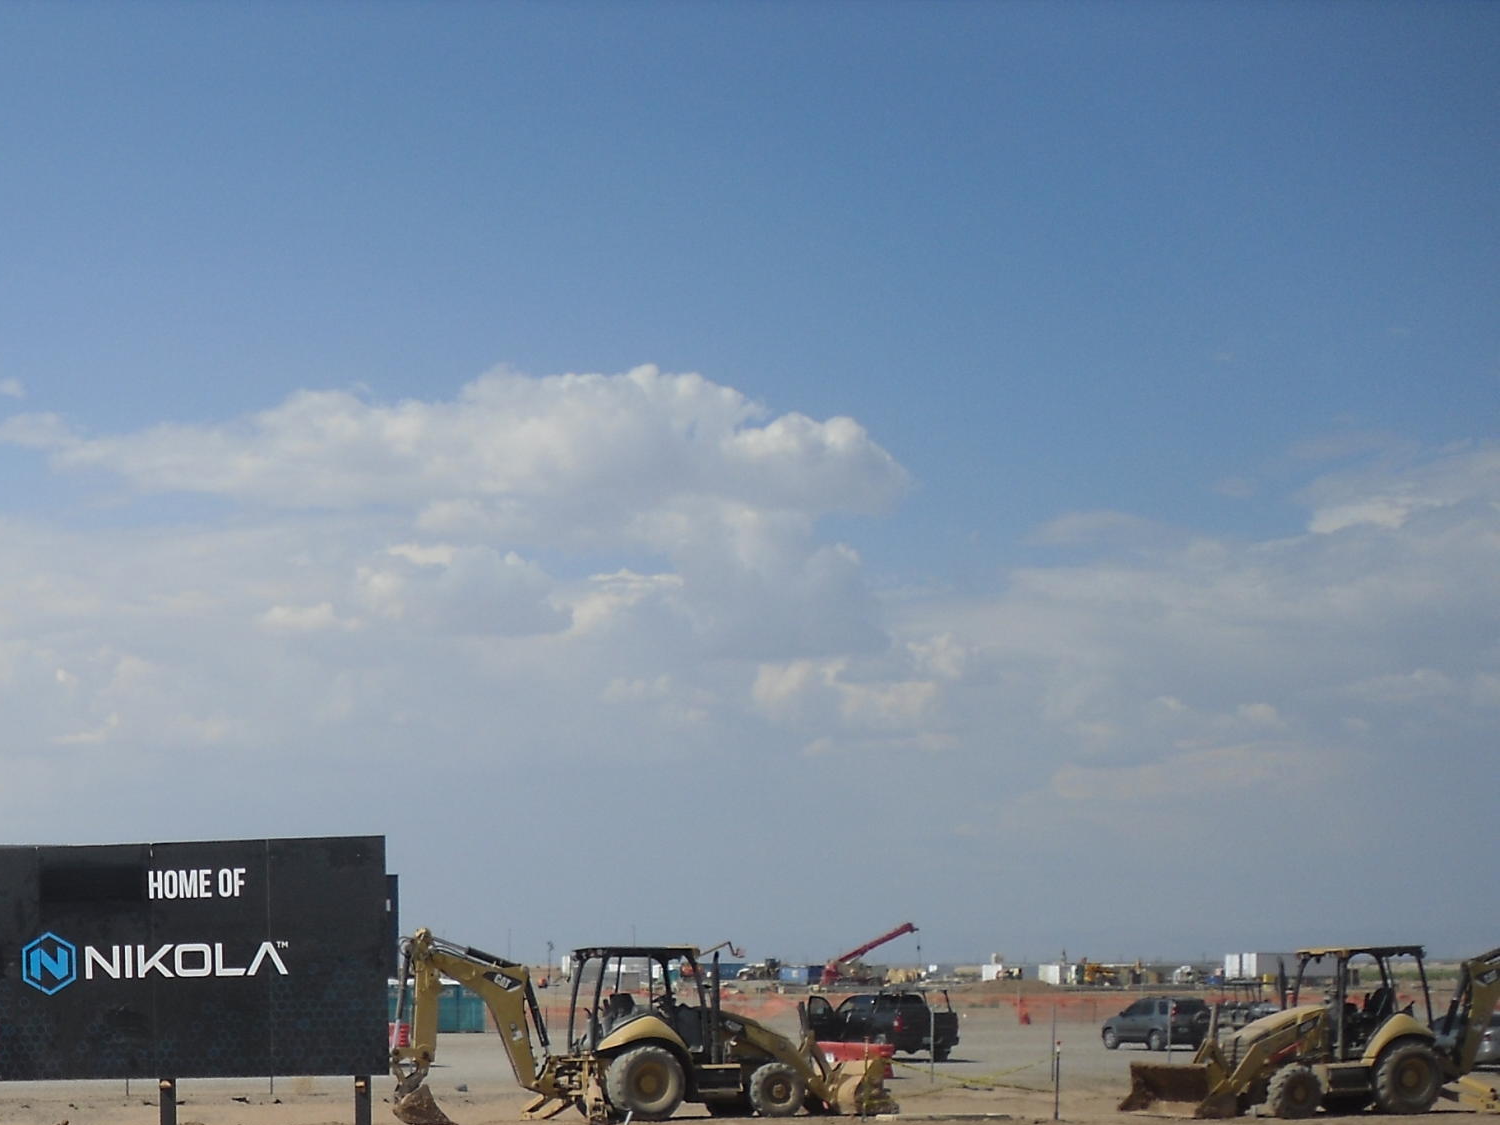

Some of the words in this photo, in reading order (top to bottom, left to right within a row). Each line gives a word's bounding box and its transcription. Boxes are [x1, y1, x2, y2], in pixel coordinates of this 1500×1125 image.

[148, 869, 212, 900] HOME
[218, 868, 246, 897] OF
[84, 941, 289, 980] NIKOLA
[494, 973, 511, 989] CAT
